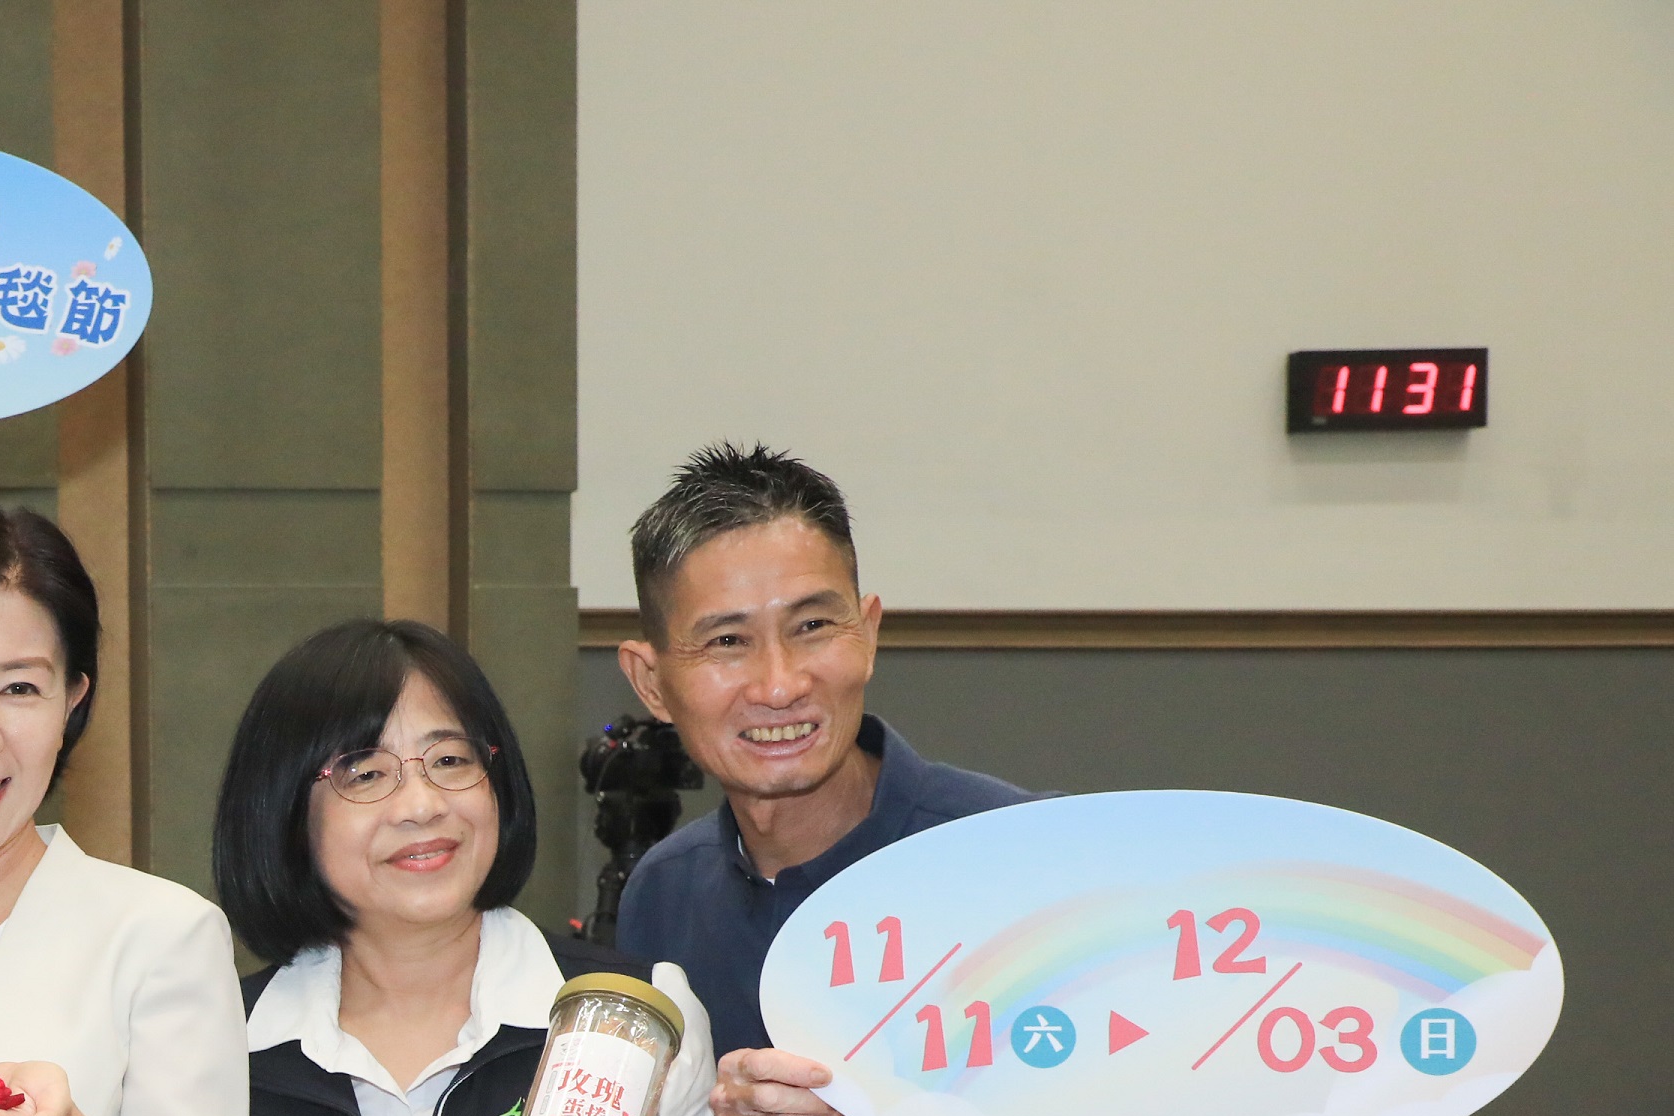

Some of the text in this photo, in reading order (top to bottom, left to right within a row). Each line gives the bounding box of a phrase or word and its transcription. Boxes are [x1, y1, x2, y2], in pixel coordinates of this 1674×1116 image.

[1023, 1016, 1064, 1054] 六
[1421, 1018, 1457, 1060] 日
[559, 1067, 624, 1111] 玫瑰
